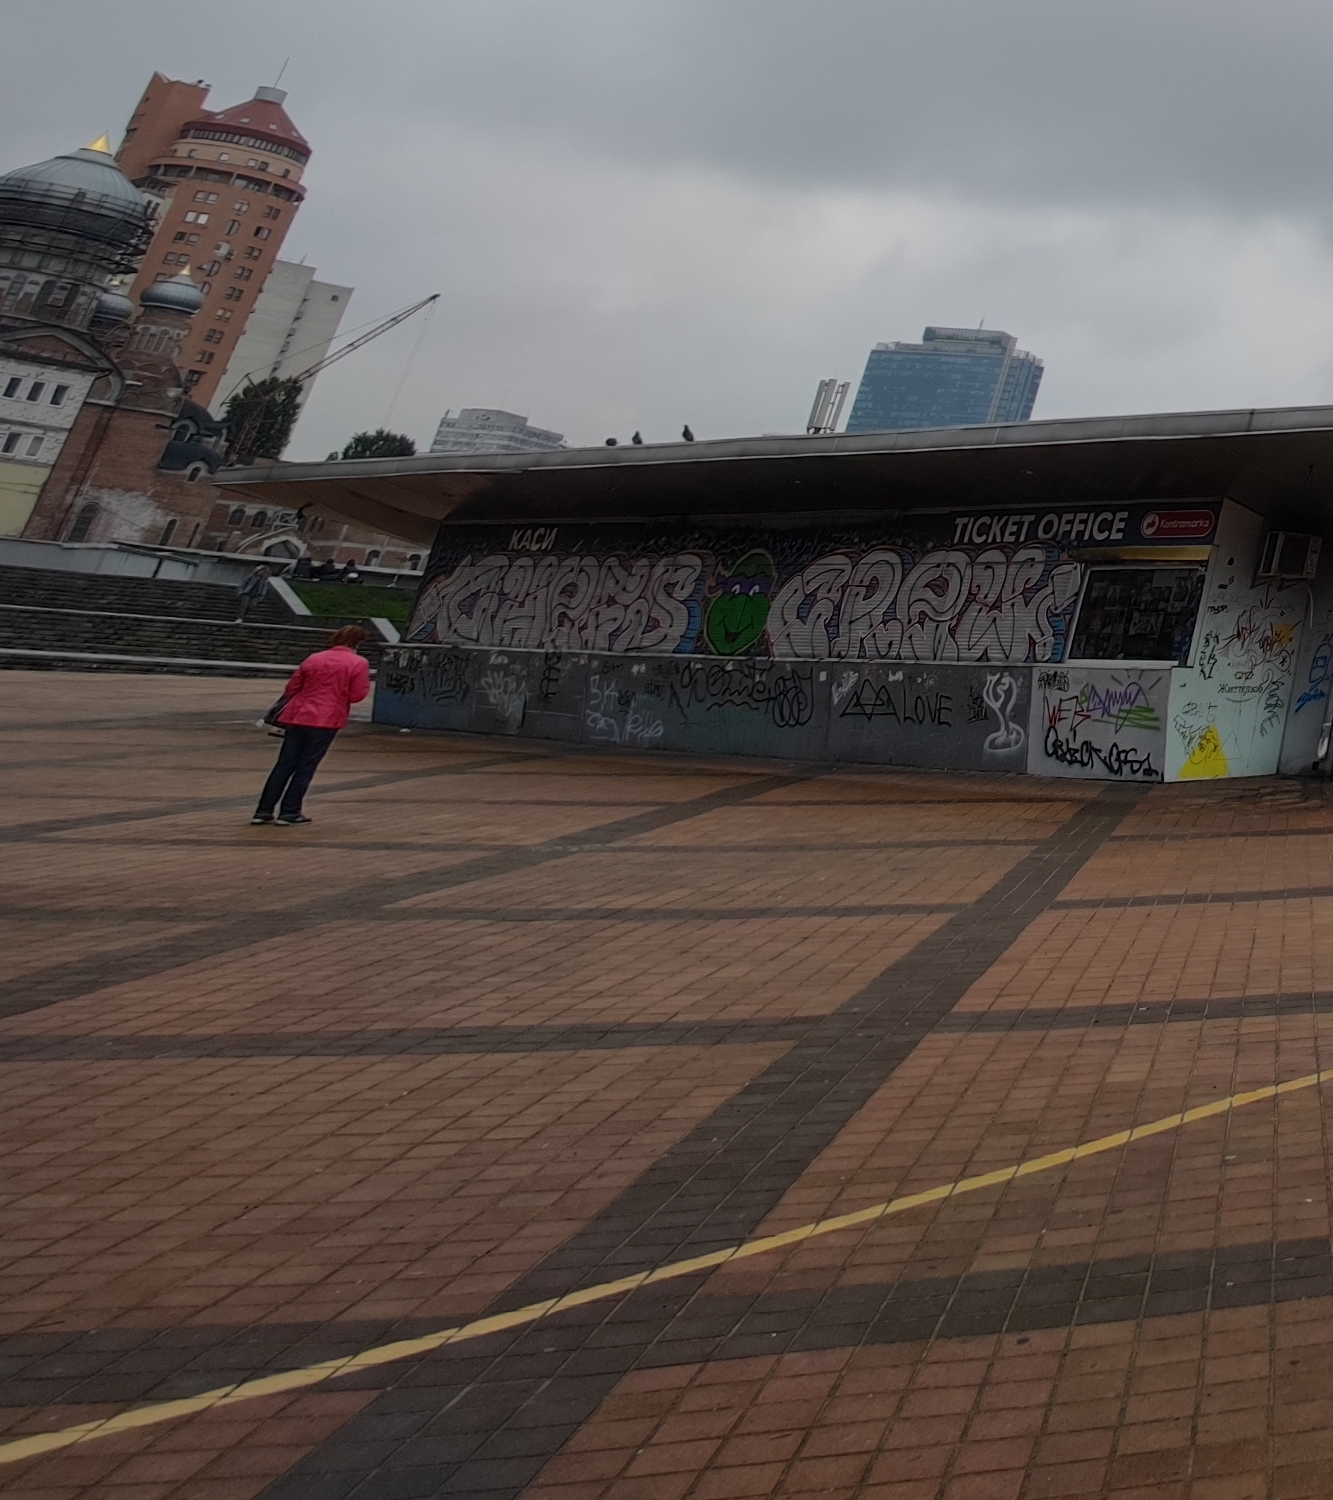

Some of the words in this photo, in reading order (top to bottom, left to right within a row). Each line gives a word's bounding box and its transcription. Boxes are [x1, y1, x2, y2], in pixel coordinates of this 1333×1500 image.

[508, 527, 558, 551] КАСИ
[953, 514, 1036, 544] TICKET
[1037, 511, 1129, 542] OFFICE
[903, 682, 953, 726] LOVE
